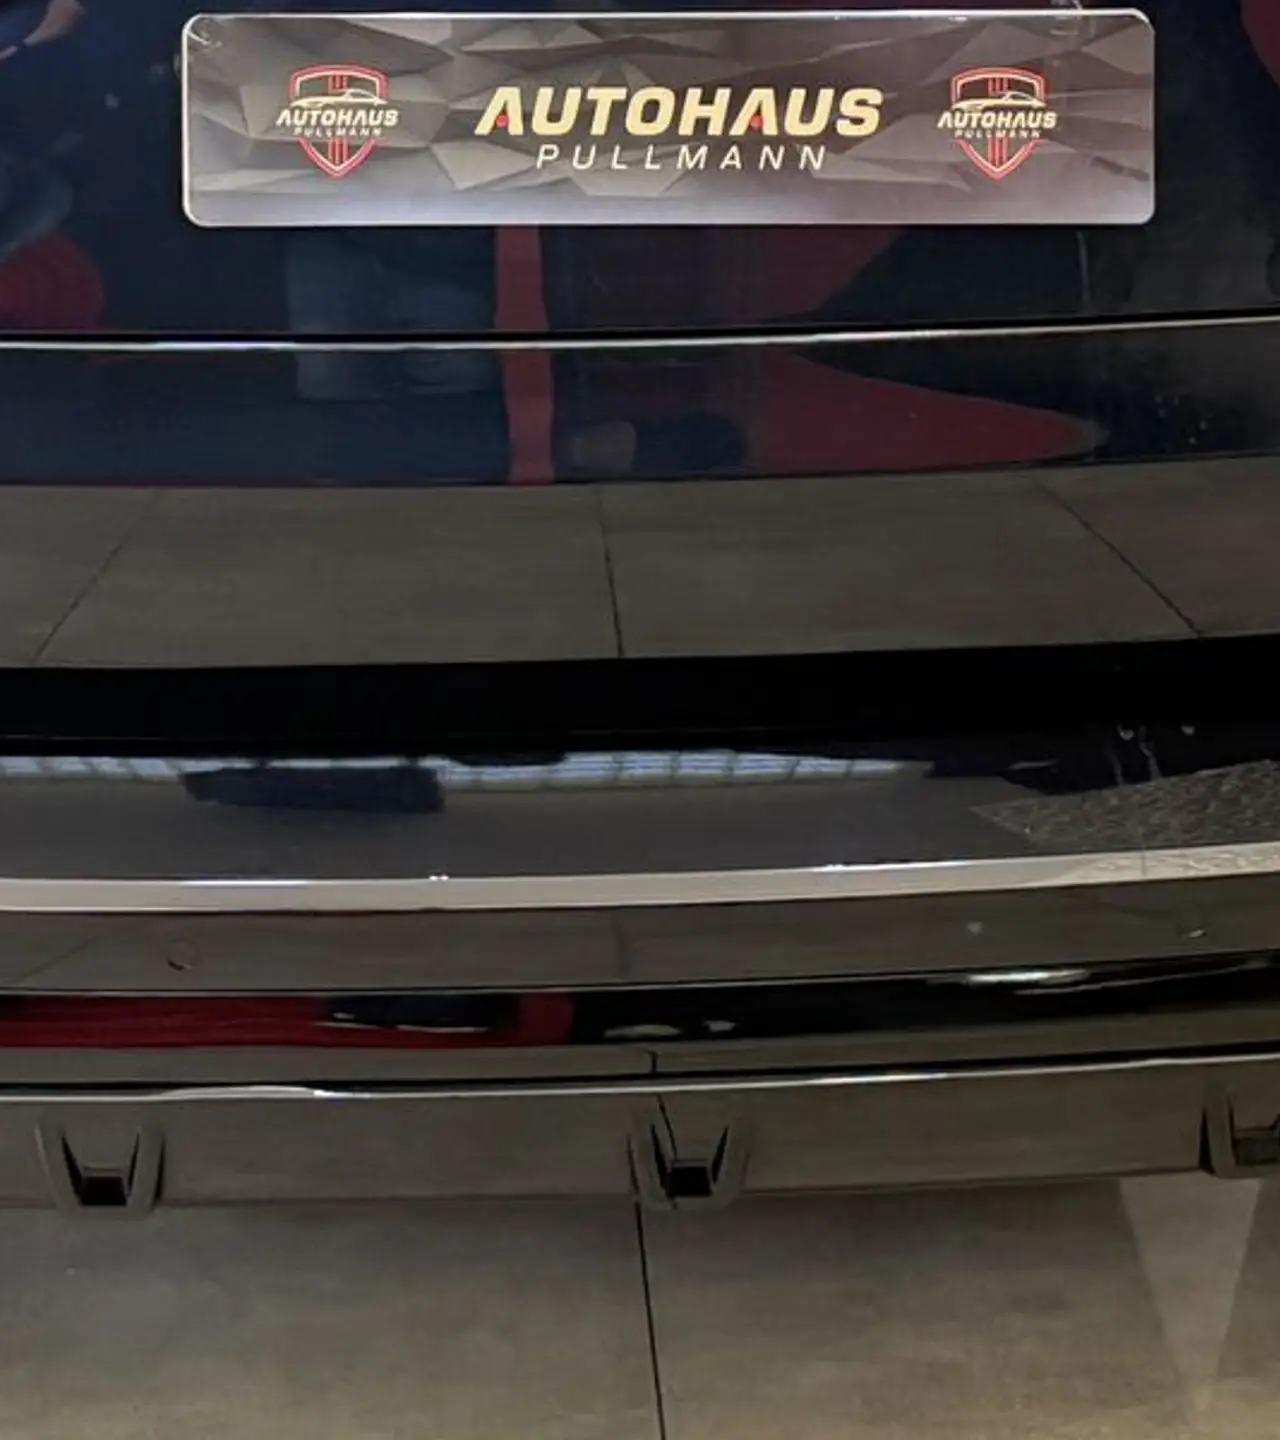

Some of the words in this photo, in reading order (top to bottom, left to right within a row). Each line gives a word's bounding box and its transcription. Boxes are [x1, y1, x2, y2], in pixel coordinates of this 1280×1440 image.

[276, 109, 400, 127] AUTOHAUS
[475, 86, 883, 137] AUTOHAUS
[937, 110, 1058, 129] AUTOHAUS
[294, 127, 383, 138] PULLMANN
[954, 129, 1041, 139] PULLMANN
[536, 143, 826, 170] PULLMANN
